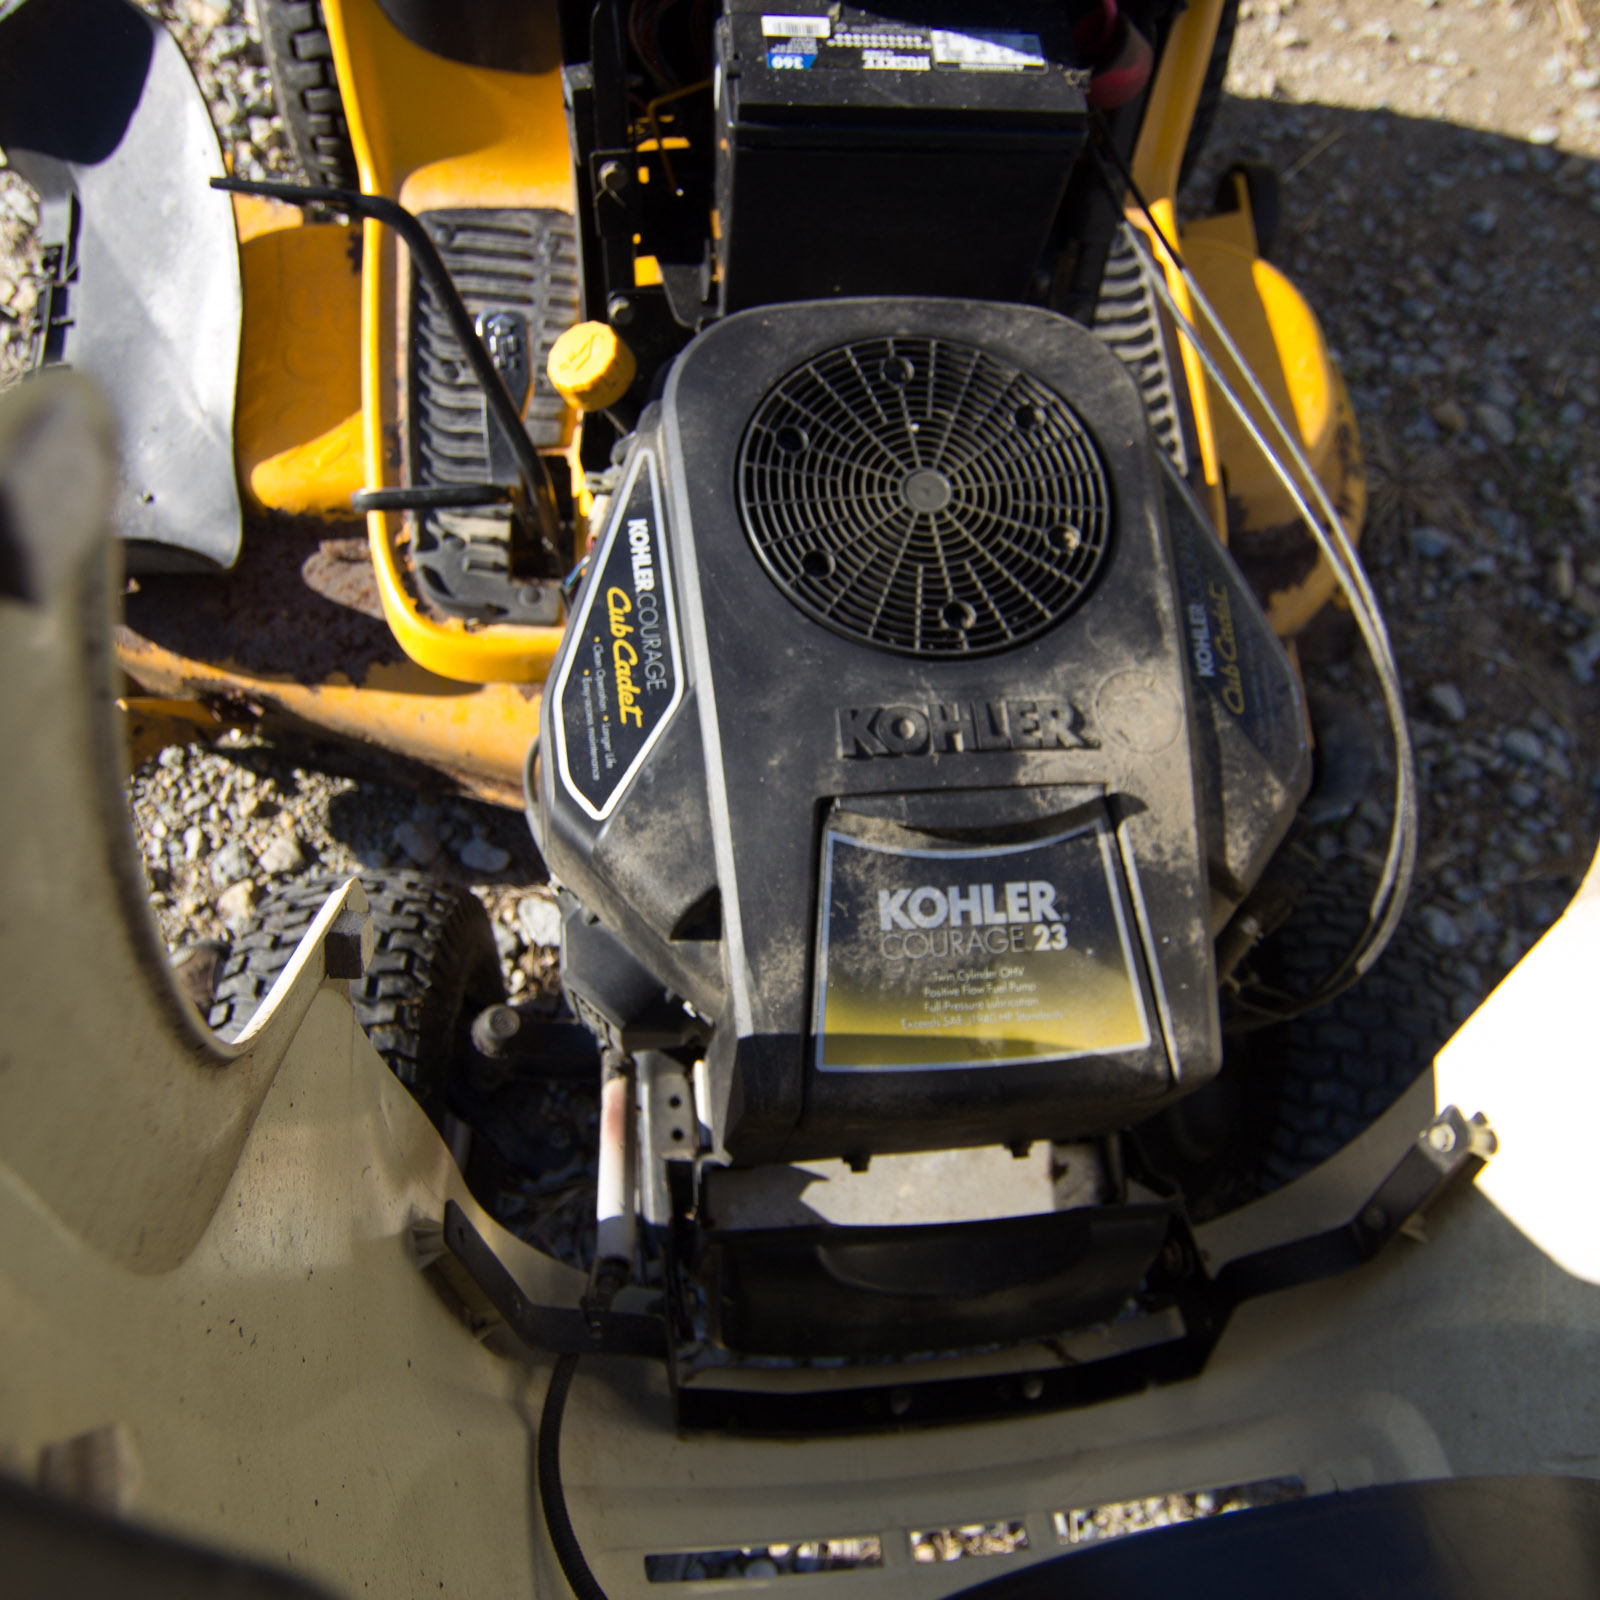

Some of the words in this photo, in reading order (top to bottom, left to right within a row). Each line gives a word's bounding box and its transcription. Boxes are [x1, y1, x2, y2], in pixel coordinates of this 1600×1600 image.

[771, 56, 804, 69] 360
[627, 518, 655, 593] KOHLER
[607, 586, 634, 637] Cub
[1208, 580, 1237, 662] Cadet
[593, 643, 604, 668] Clean
[636, 593, 667, 691] COURAGE
[1188, 603, 1215, 676] KOHLER
[595, 668, 608, 712] Operation
[613, 638, 643, 728] Cadet
[1222, 663, 1245, 714] Cub
[588, 726, 600, 781] maintenance
[600, 722, 611, 751] Longer
[836, 701, 1094, 757] KOHLER
[878, 880, 1062, 931] KOHLER
[882, 926, 1024, 960] COURAGE
[1033, 923, 1069, 951] 23
[924, 985, 960, 998] Positive
[962, 983, 985, 995] Flow
[987, 982, 1007, 994] Fuel
[1010, 981, 1038, 993] Pump
[932, 970, 956, 982] Twin
[959, 967, 997, 982] Cylinder
[1000, 966, 1025, 979] OHV
[924, 1001, 942, 1013] Full
[944, 1000, 985, 1012] Pressure
